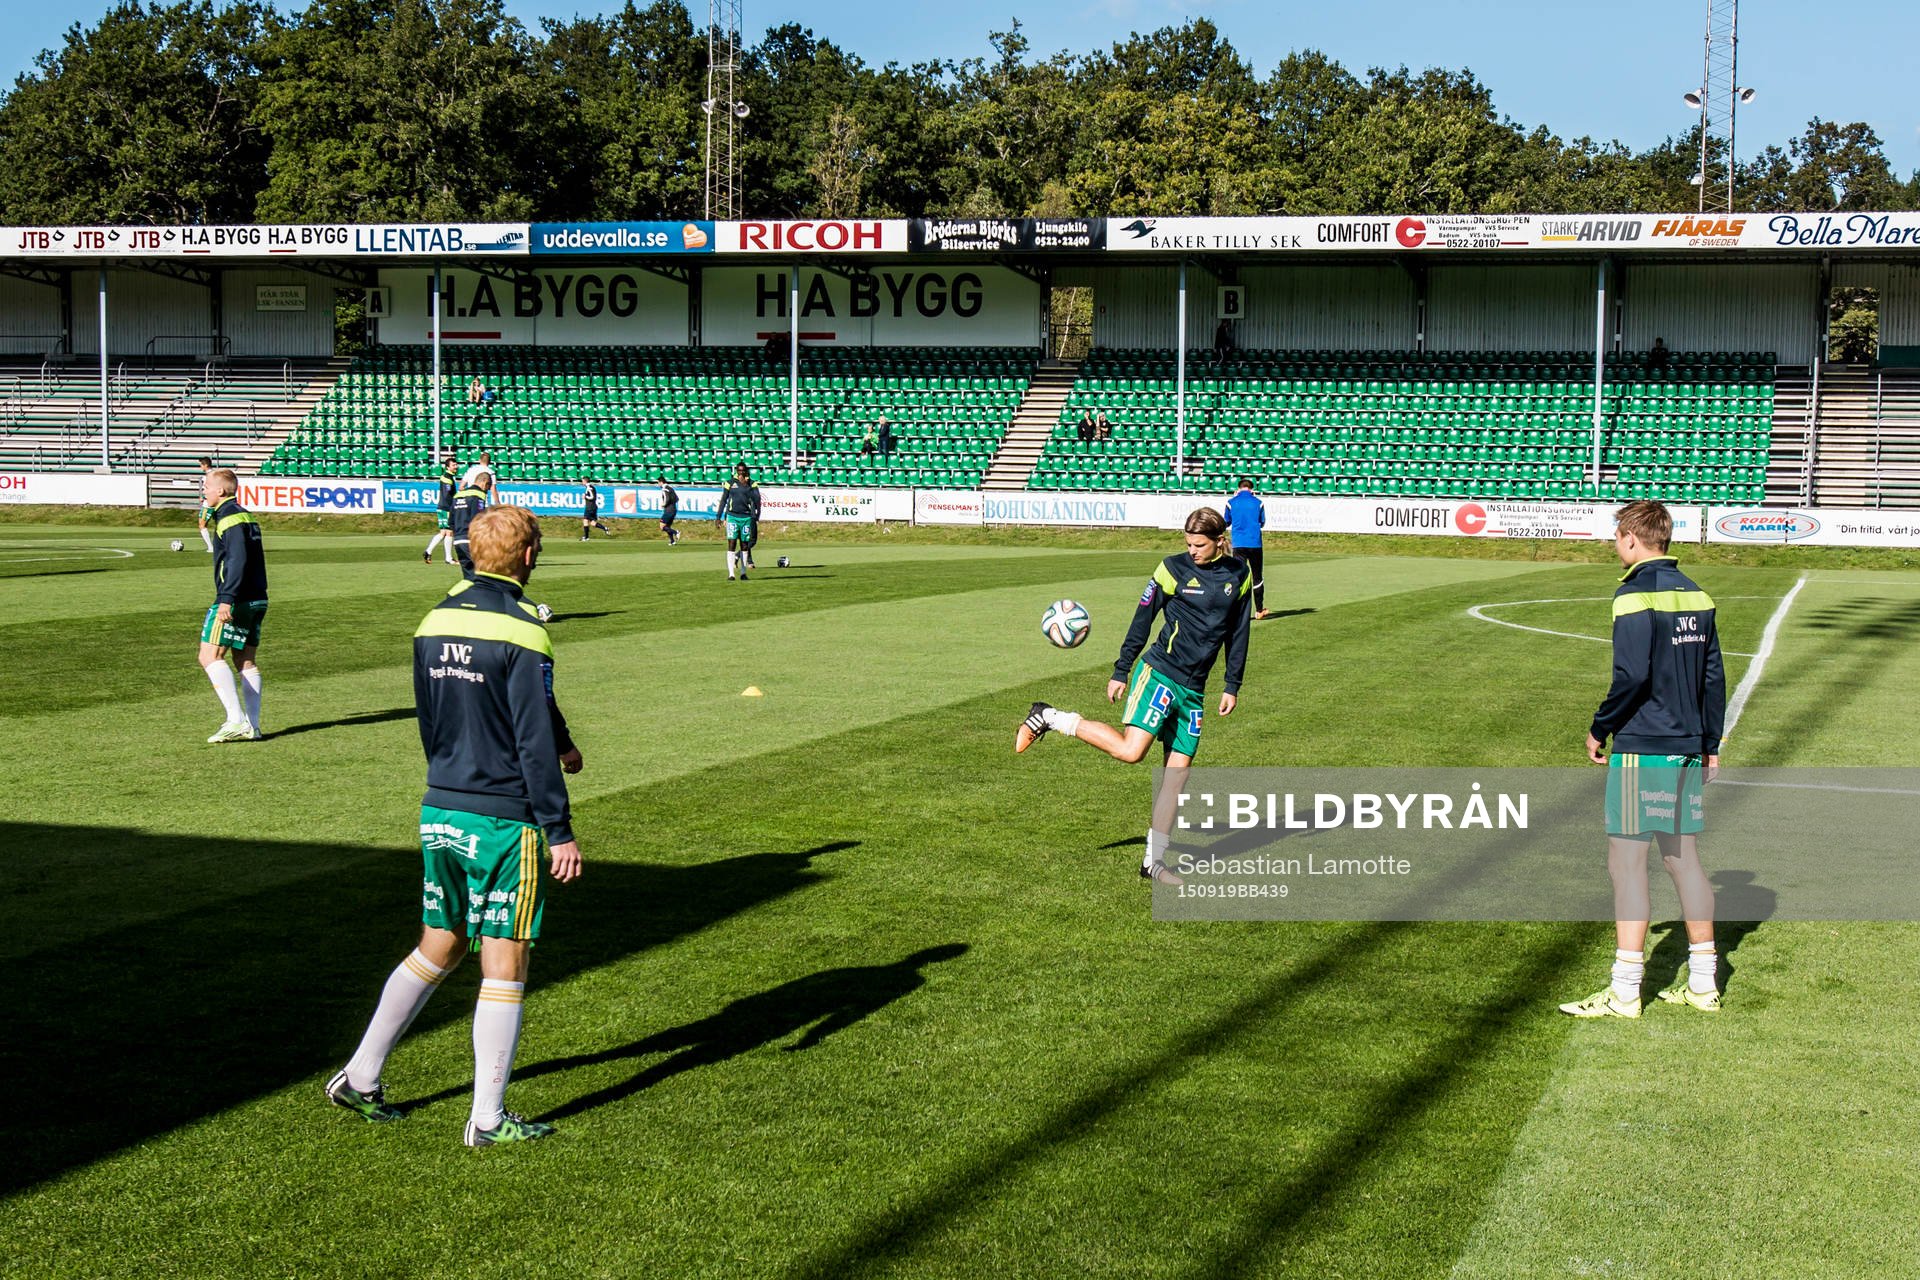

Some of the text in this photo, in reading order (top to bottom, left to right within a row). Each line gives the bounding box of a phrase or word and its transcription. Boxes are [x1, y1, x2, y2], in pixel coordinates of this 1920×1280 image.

[214, 228, 261, 245] BYGG
[301, 227, 348, 245] BYGG
[739, 222, 882, 250] RICOH
[924, 220, 1017, 245] Bröderna Björks
[1035, 222, 1088, 234] Ljungskile
[1317, 222, 1391, 243] COMFORT
[1541, 221, 1642, 241] STARKE ARVID
[1768, 215, 1843, 245] Bella
[18, 231, 50, 250] JTB
[73, 231, 105, 250] JTB
[128, 231, 161, 249] JTB
[543, 229, 668, 249] uddevalla.se
[941, 239, 1000, 250] Bilservice
[1151, 235, 1302, 249] BAKER TILLY SEK
[1446, 239, 1501, 248] 0522-20107
[370, 290, 383, 313] A
[514, 274, 638, 318] BYGG
[850, 273, 983, 318] BYGG
[1224, 290, 1239, 315] B
[237, 485, 377, 509] INTERSPORT
[384, 489, 419, 504] HELA
[812, 495, 825, 504] Vi
[825, 505, 859, 516] FÄRG
[984, 498, 1127, 521] BOHUSLÄNINGEN
[1375, 506, 1450, 528] COMFORT
[1507, 527, 1563, 538] 0522-20107
[1739, 525, 1797, 533] MARIN
[1888, 524, 1908, 535] vårt
[1142, 708, 1161, 728] 13
